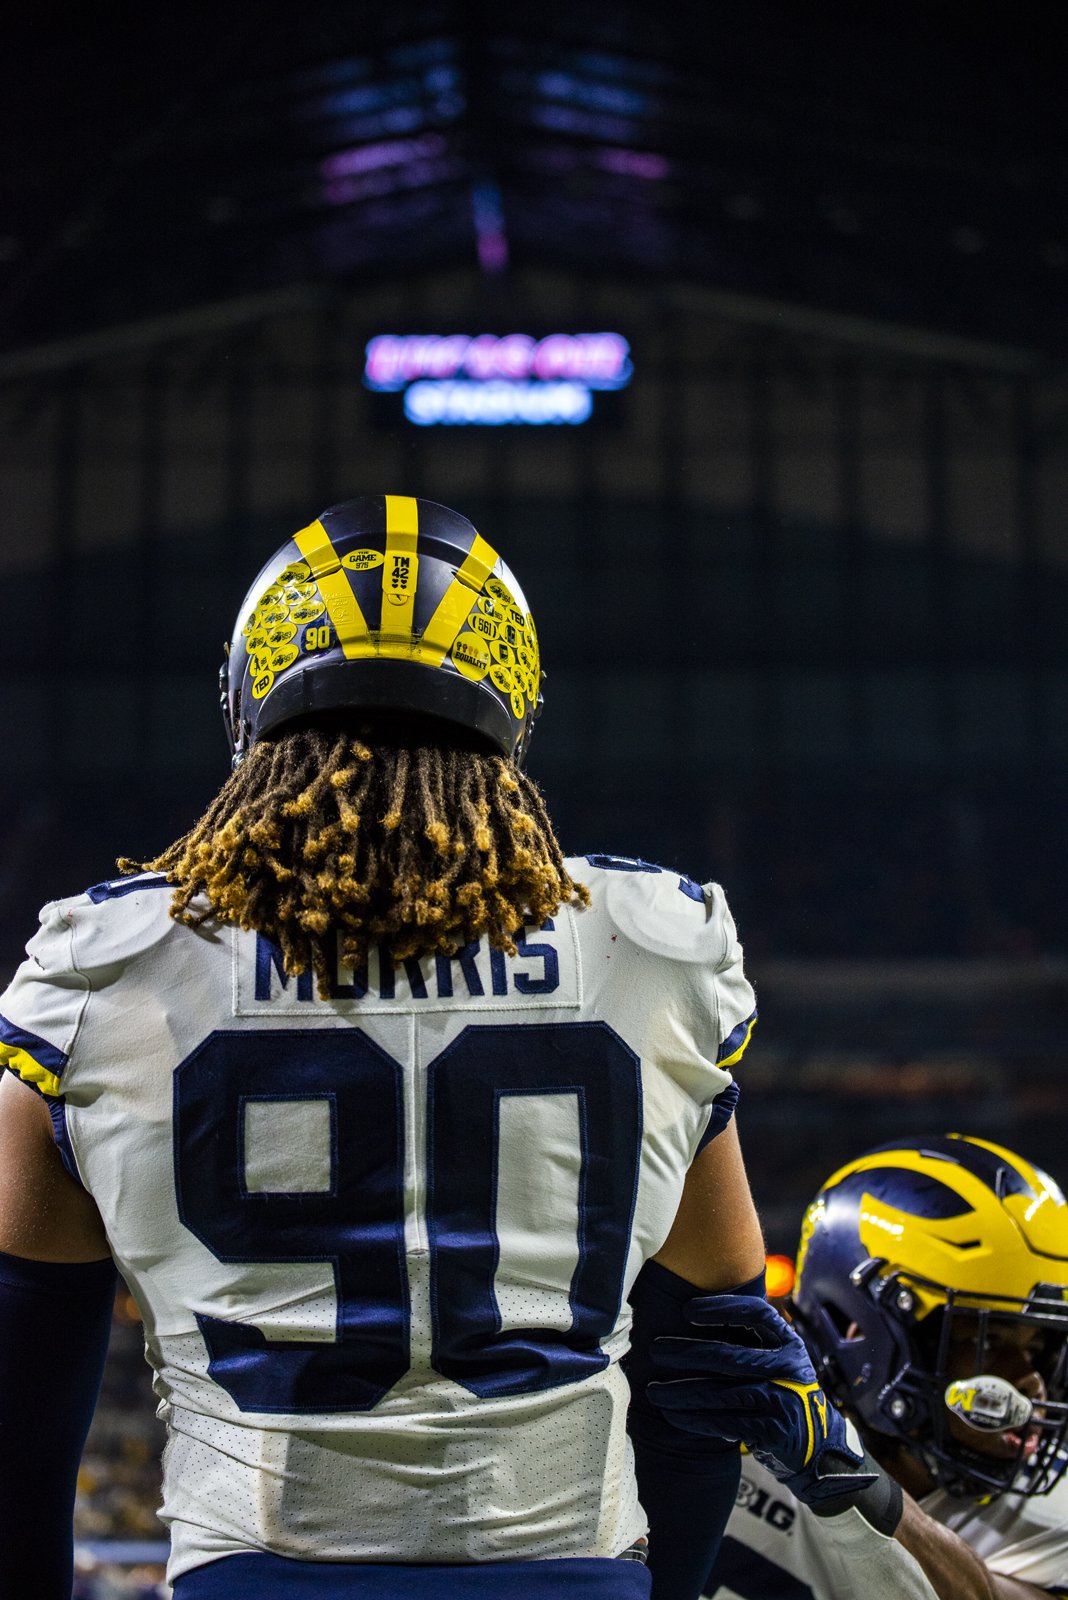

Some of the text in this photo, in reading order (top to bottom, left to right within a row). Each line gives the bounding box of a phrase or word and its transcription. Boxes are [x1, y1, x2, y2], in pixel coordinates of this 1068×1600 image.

[349, 554, 377, 563] GAME
[392, 556, 410, 568] TM
[391, 567, 410, 579] 42
[509, 608, 525, 627] TED
[305, 625, 330, 651] 90
[454, 651, 488, 671] EQUALITY
[255, 675, 270, 695] TED
[173, 1021, 643, 1412] 90
